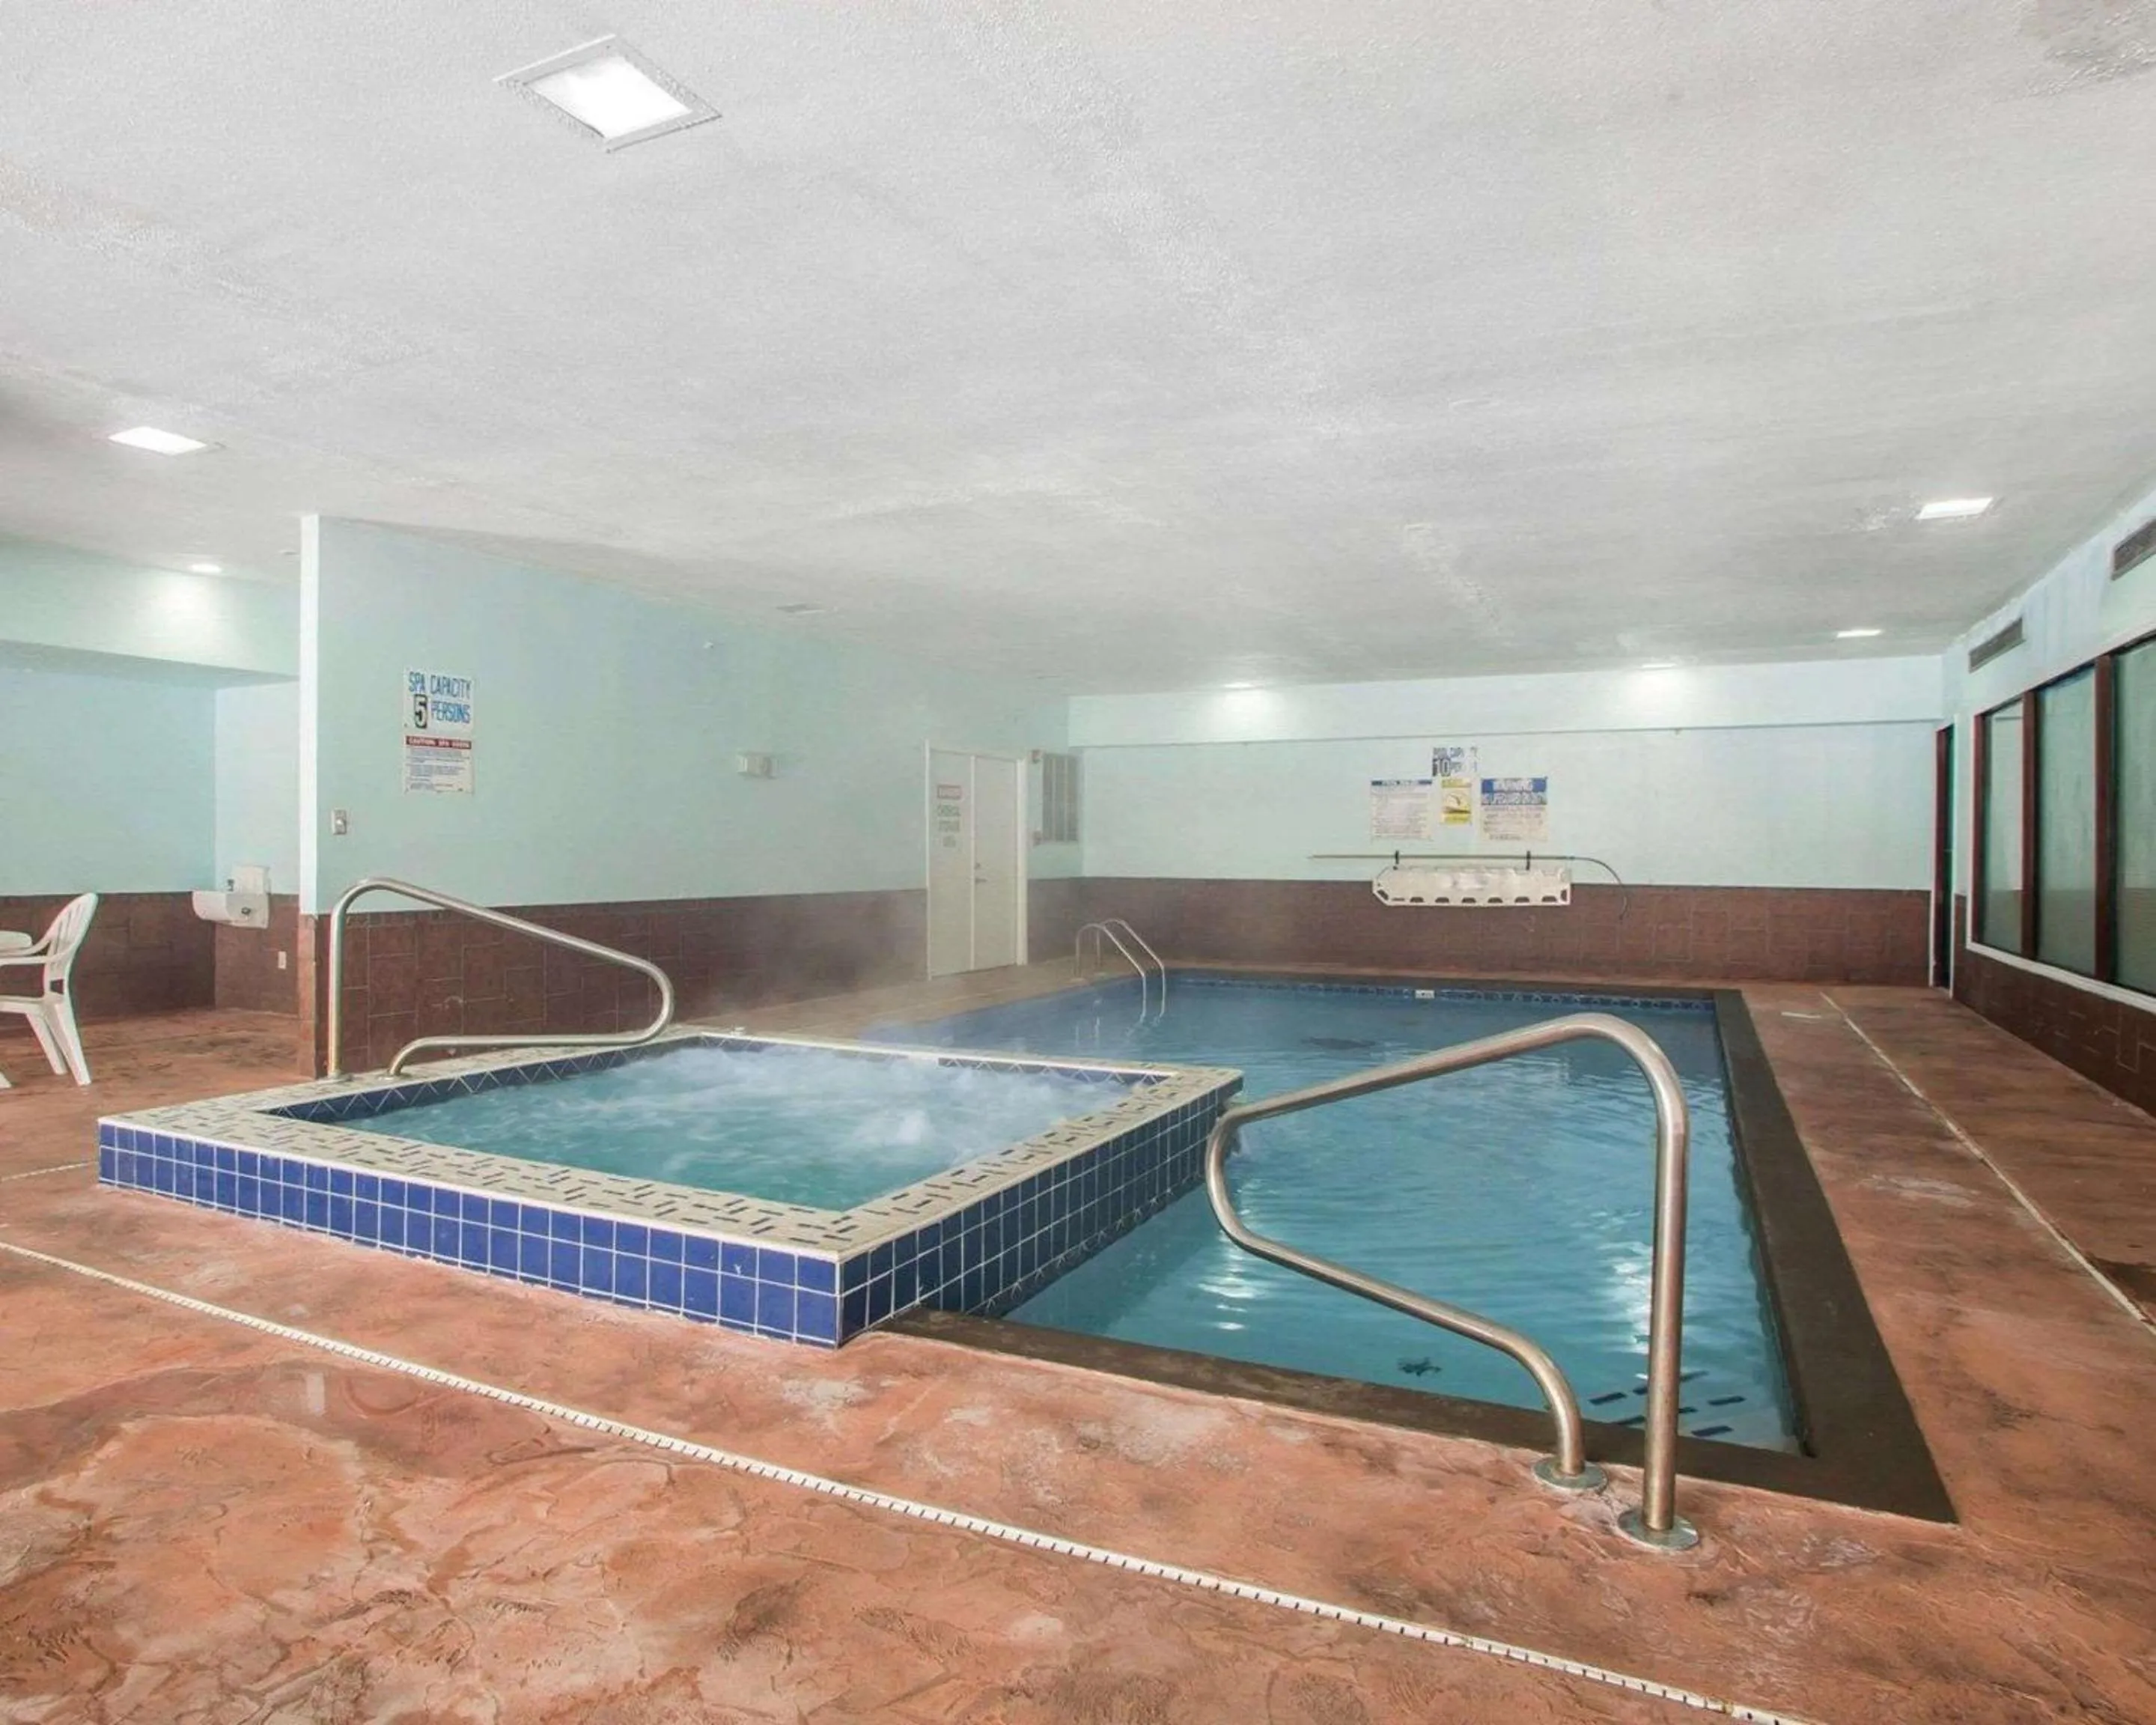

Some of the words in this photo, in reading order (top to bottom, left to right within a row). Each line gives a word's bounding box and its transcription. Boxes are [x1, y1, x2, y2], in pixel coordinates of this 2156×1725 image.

[409, 672, 425, 693] SPA
[430, 675, 471, 699] CAPACITY
[414, 694, 428, 729] 5
[430, 701, 471, 724] PERSONS
